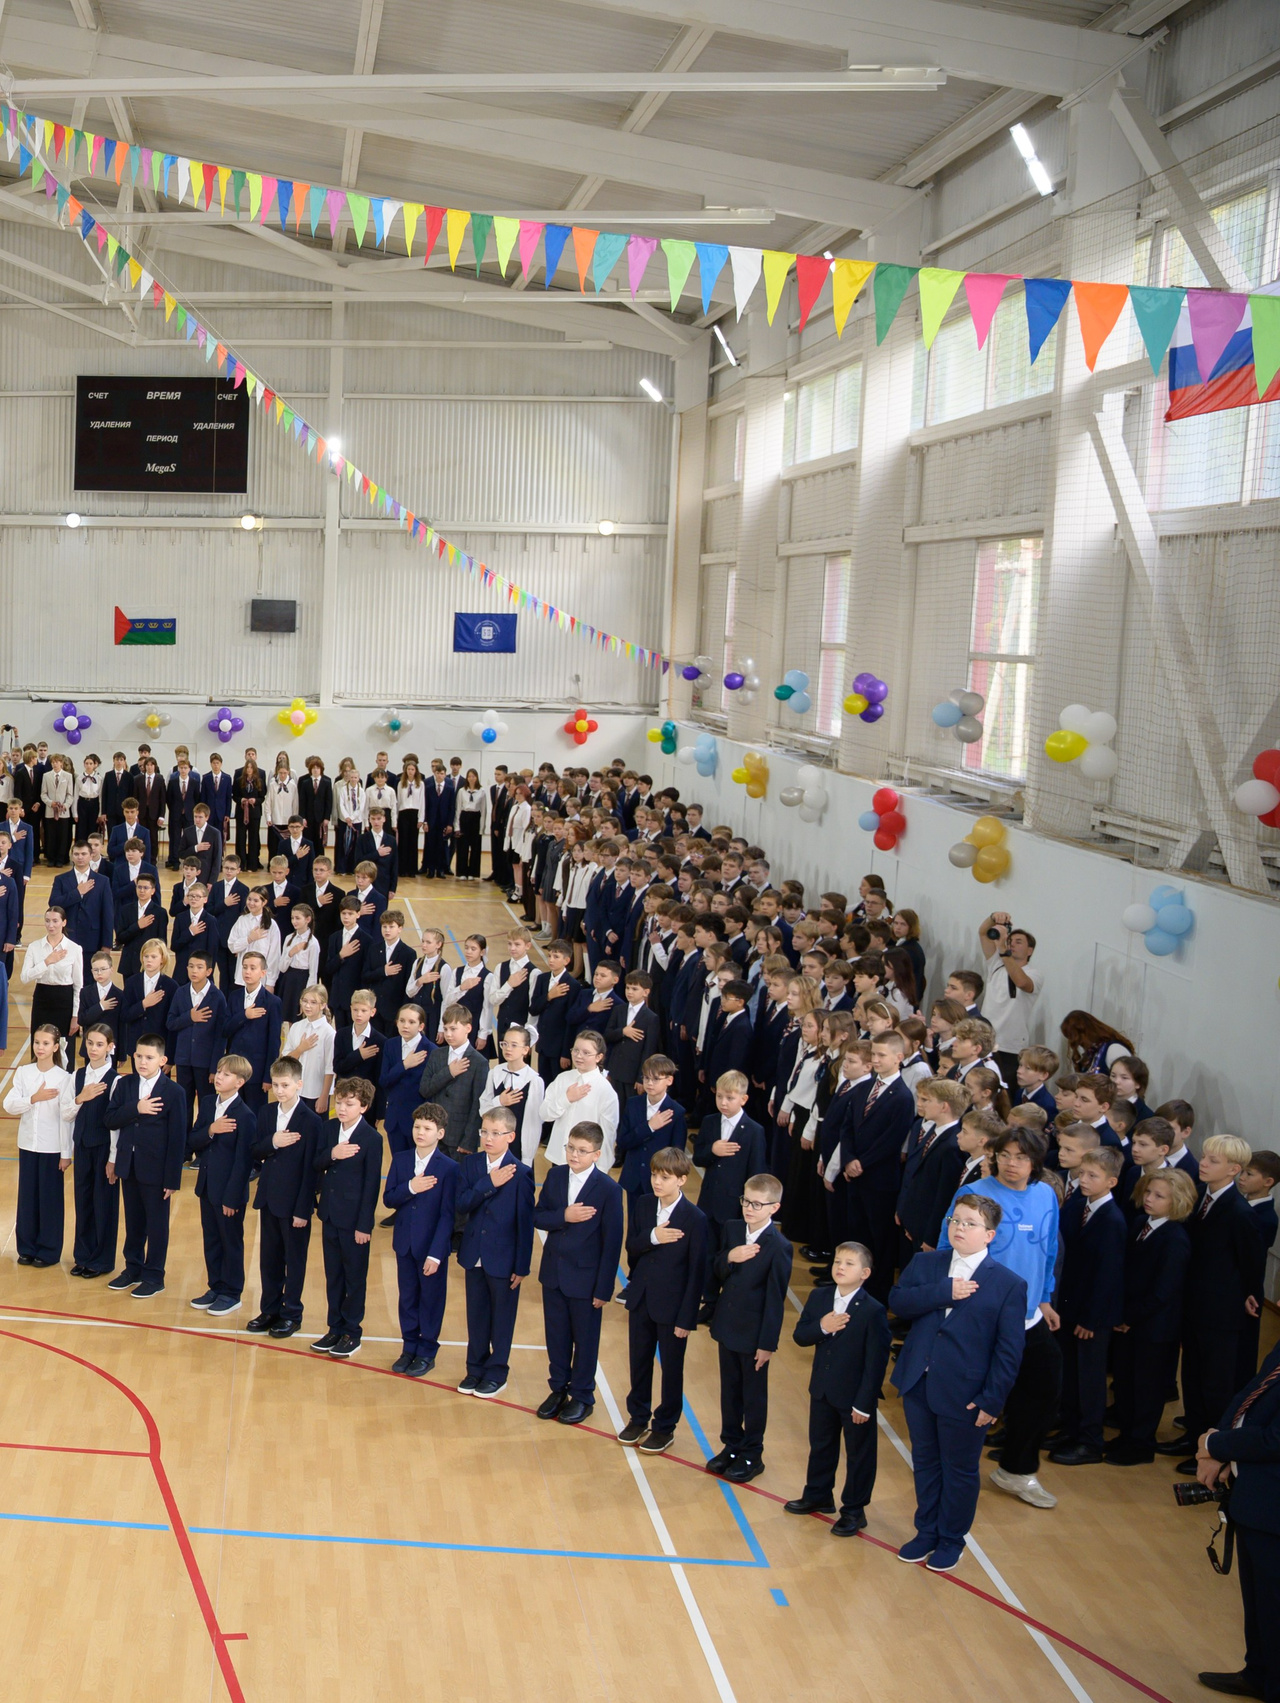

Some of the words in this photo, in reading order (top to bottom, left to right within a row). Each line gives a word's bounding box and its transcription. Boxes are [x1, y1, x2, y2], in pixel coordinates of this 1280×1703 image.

[88, 392, 109, 400] СЧЕТ
[146, 391, 182, 400] ВРЕМЯ
[217, 393, 238, 401] СЧЕТ
[89, 421, 132, 429] УДАЛЕНИЯ
[192, 422, 235, 431] УДАЛЕНИЯ
[146, 435, 178, 443] ПЕРИОД
[145, 463, 177, 474] MegaS
